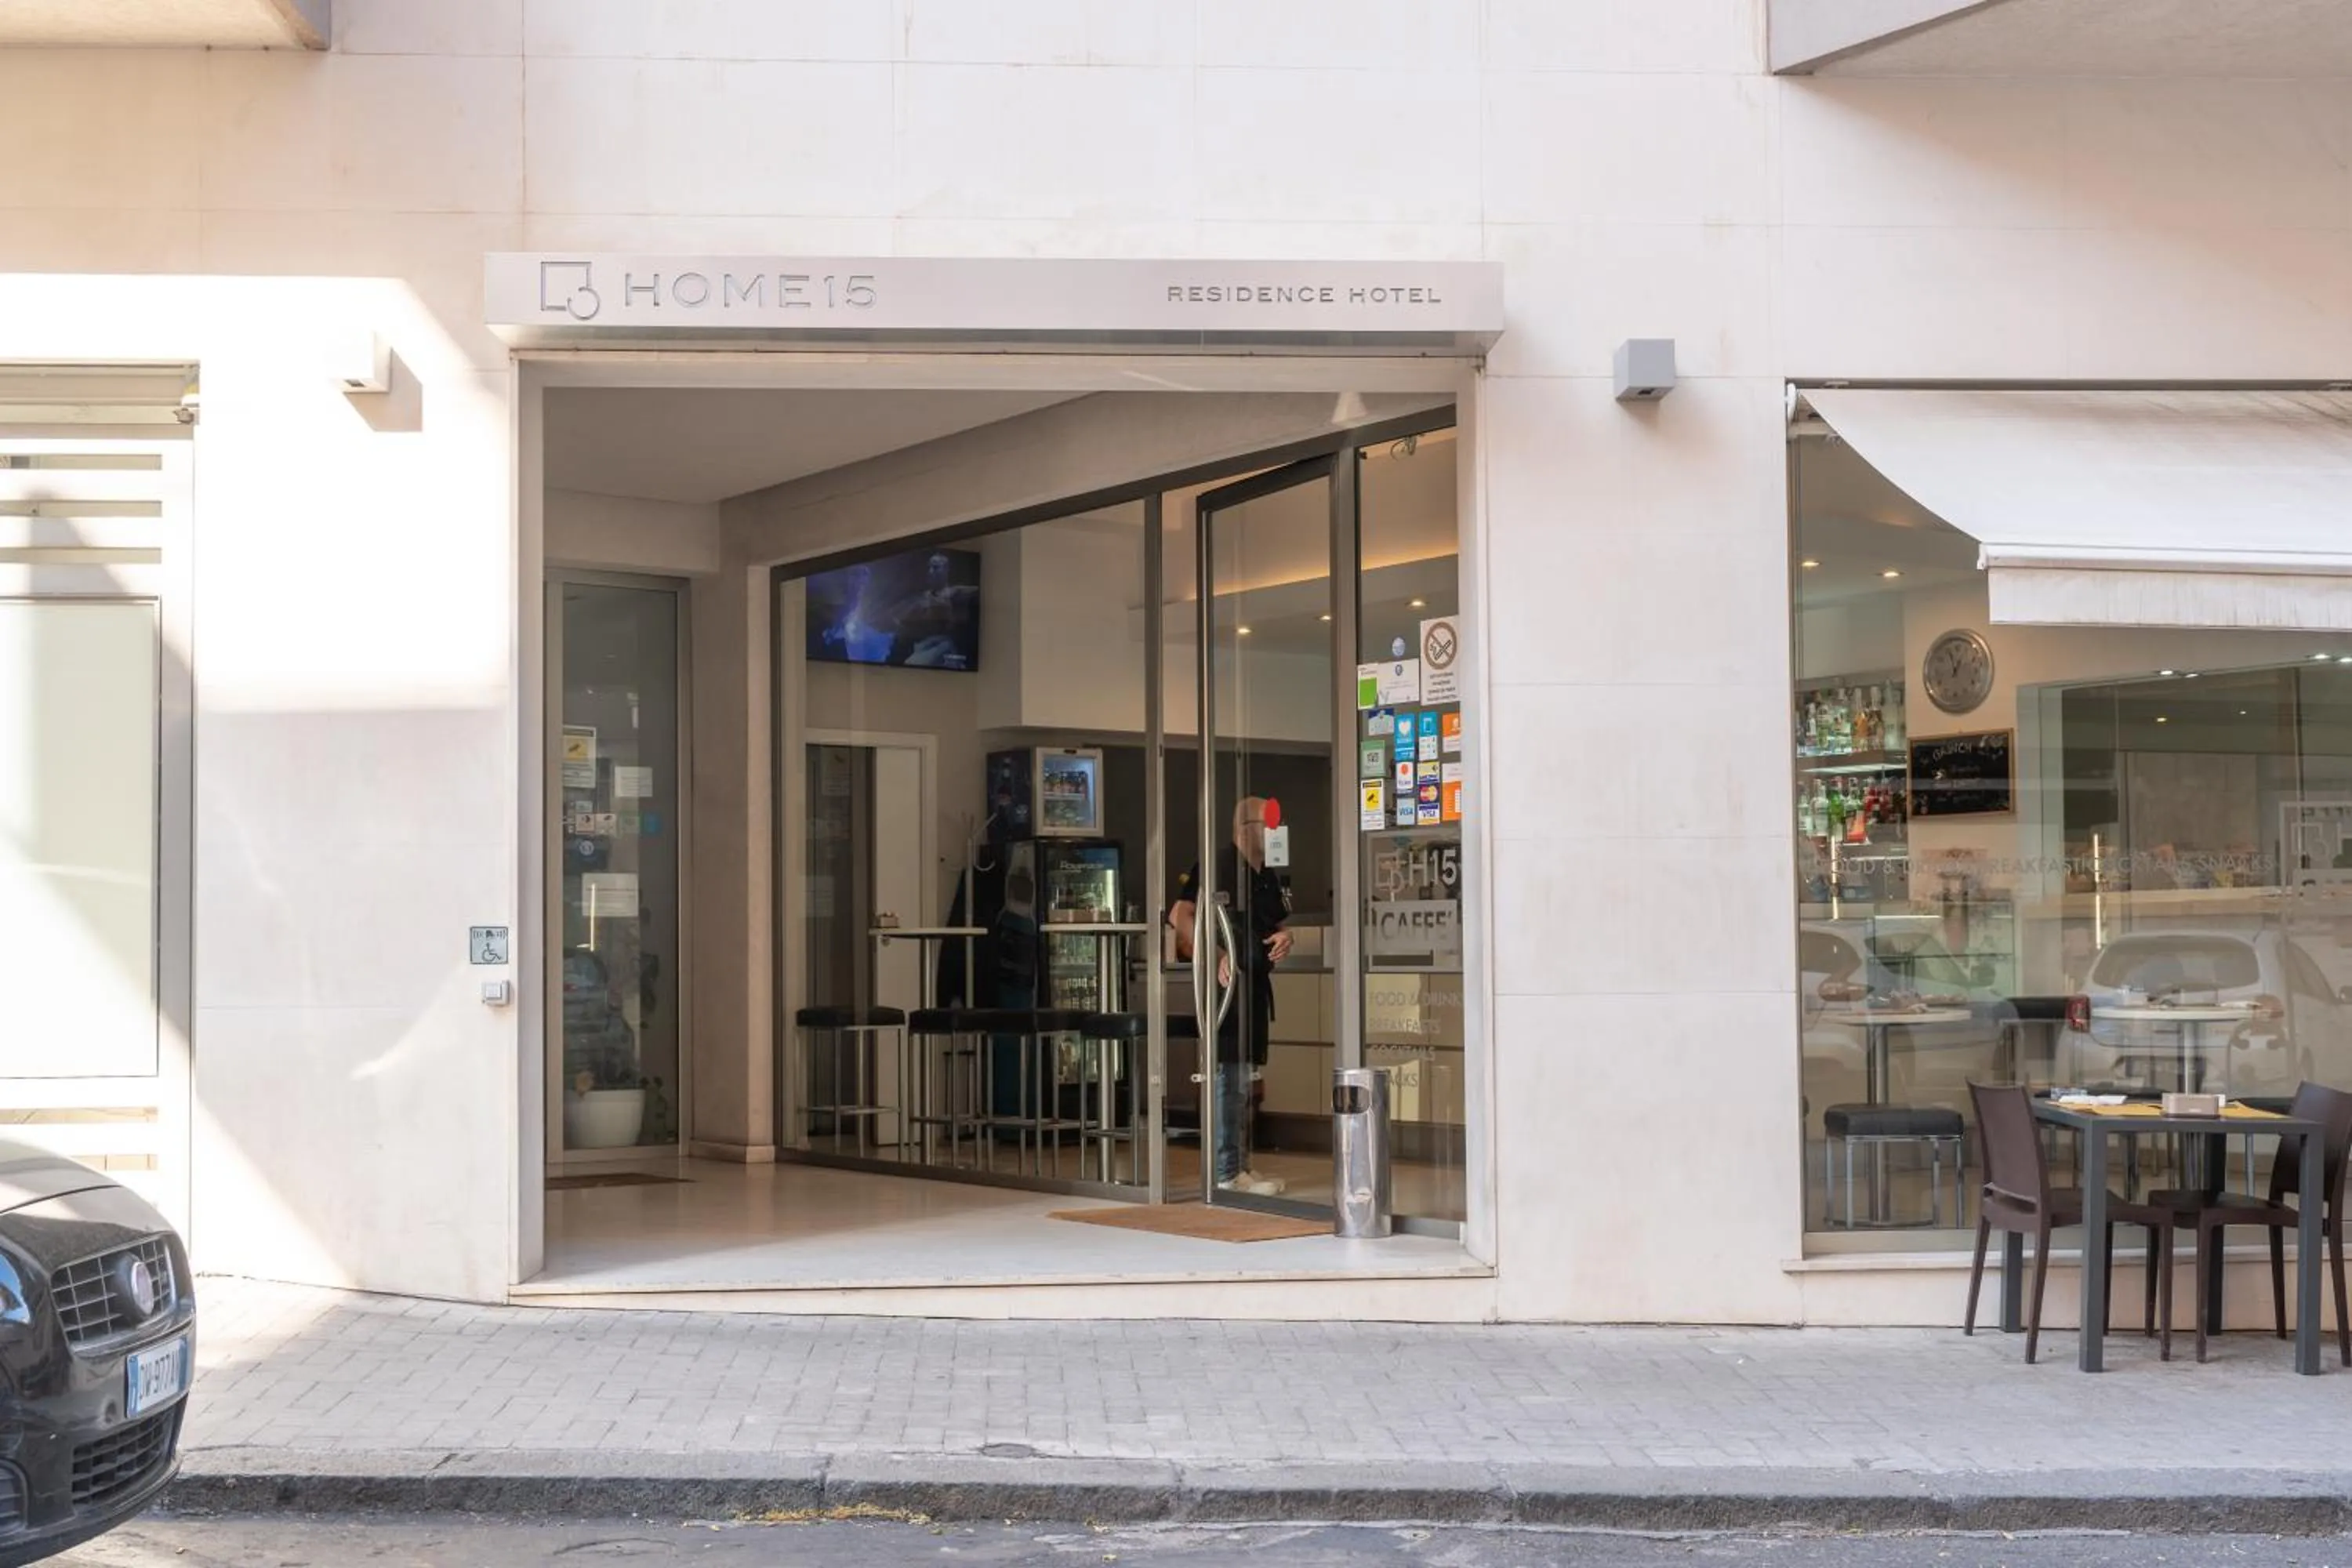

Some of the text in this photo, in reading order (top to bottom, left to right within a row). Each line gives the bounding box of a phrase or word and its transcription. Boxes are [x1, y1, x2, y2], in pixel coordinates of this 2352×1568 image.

[624, 272, 877, 310] HOME15
[1167, 286, 1443, 303] RESIDENCE HOTEL
[1408, 848, 1457, 887] H15
